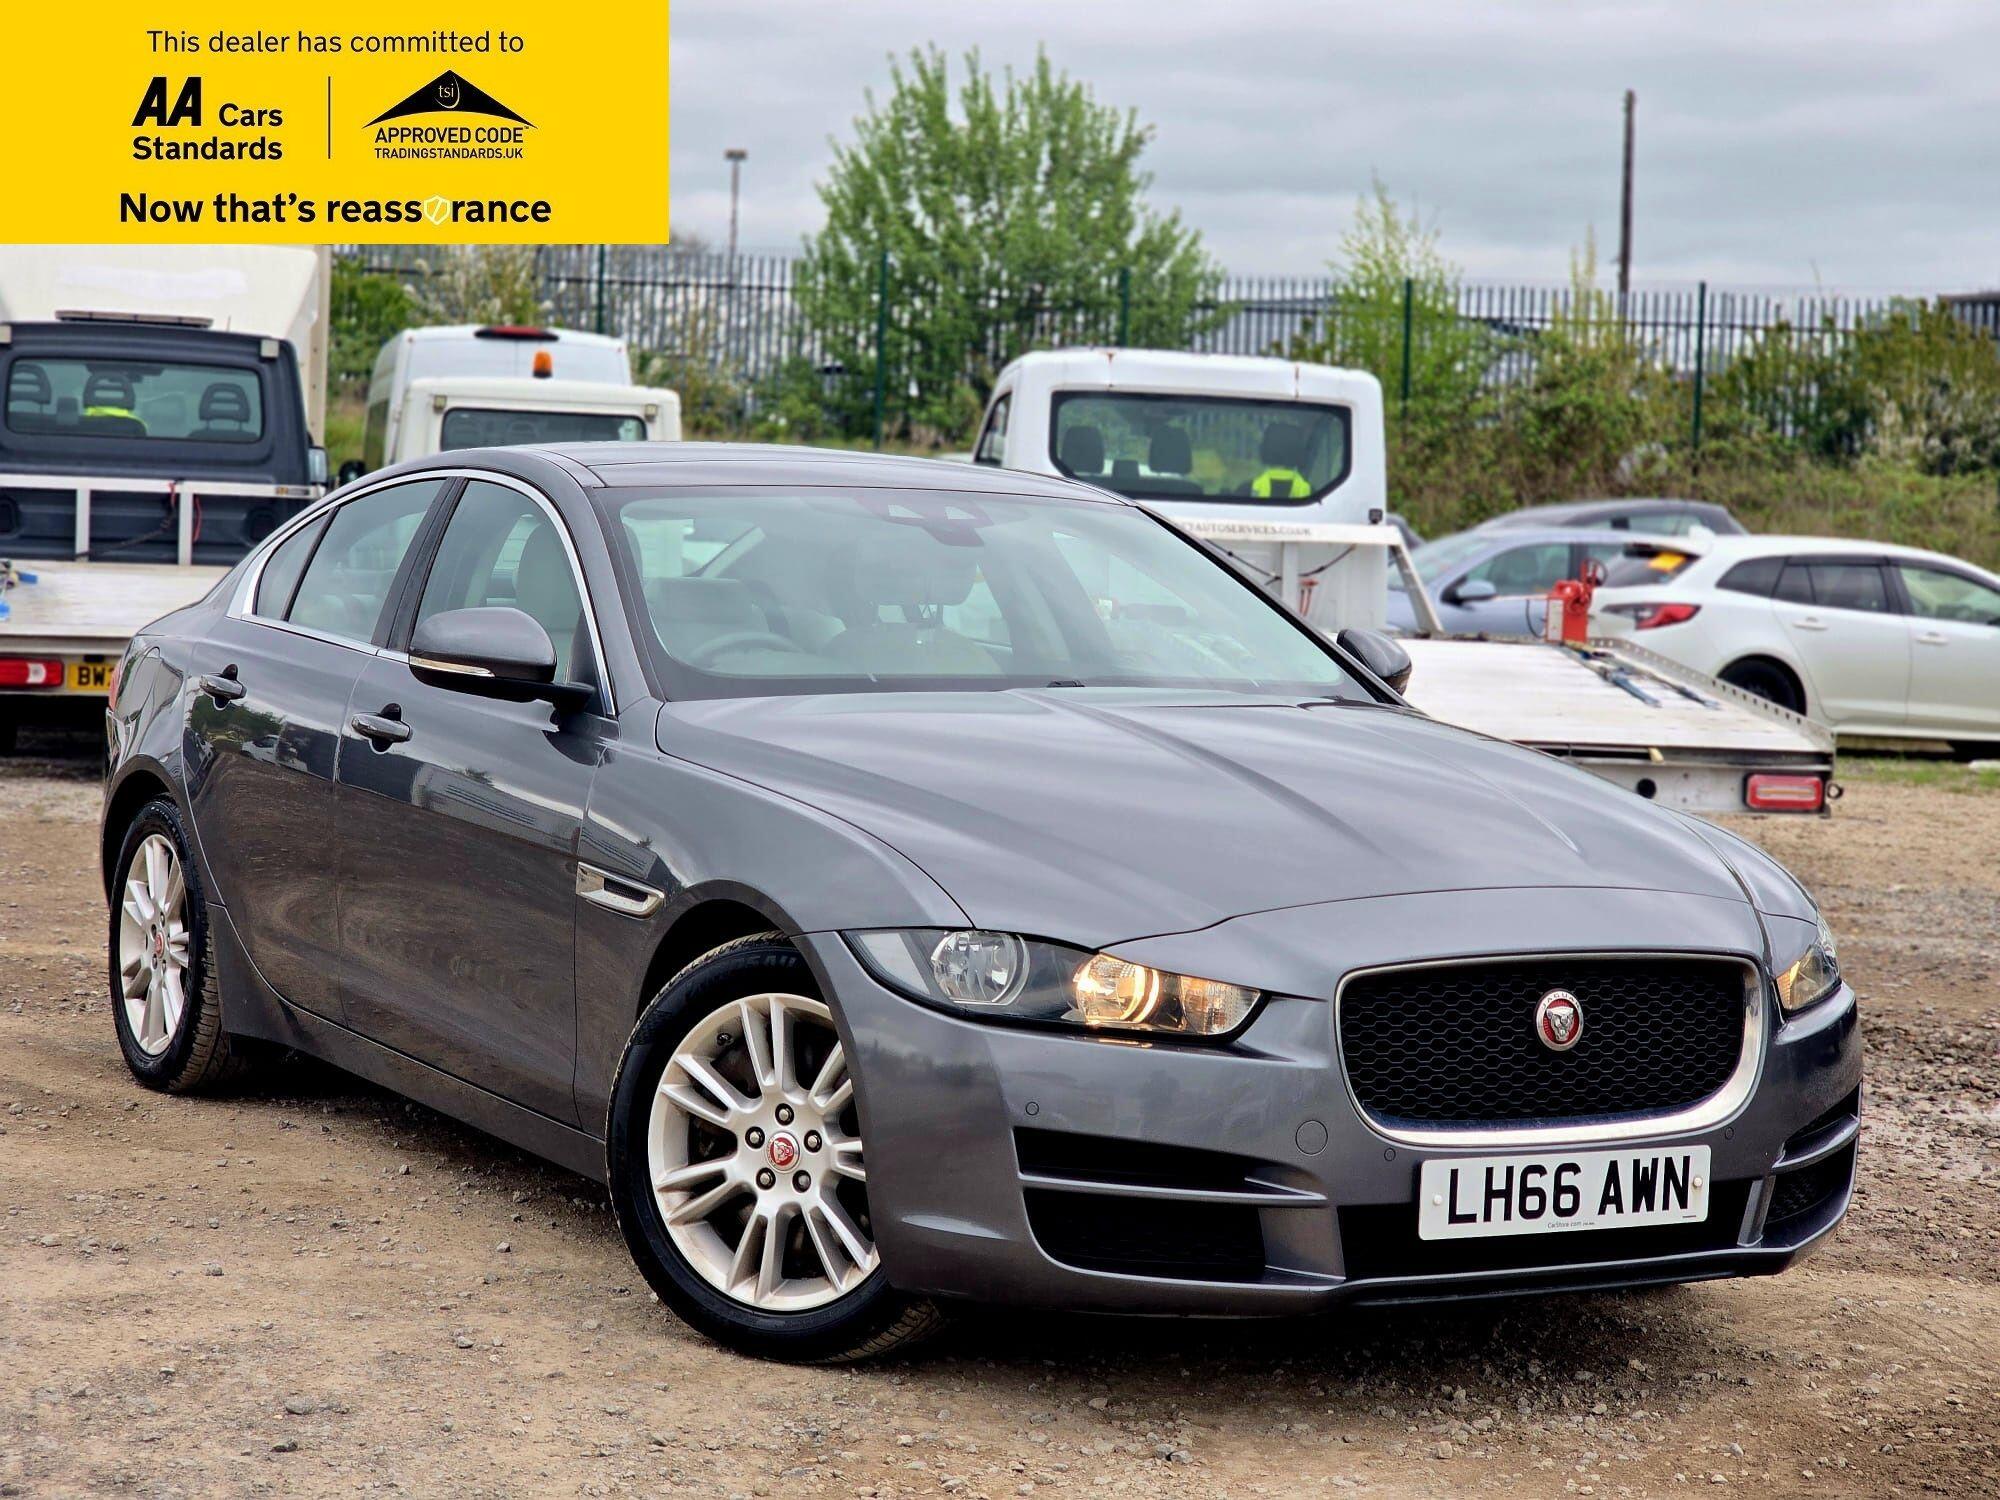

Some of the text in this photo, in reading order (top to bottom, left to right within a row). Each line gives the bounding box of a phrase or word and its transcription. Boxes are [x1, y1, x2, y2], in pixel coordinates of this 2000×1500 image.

[1541, 991, 1581, 1010] JAGUAR
[1447, 1155, 1691, 1225] LH66 AWN
